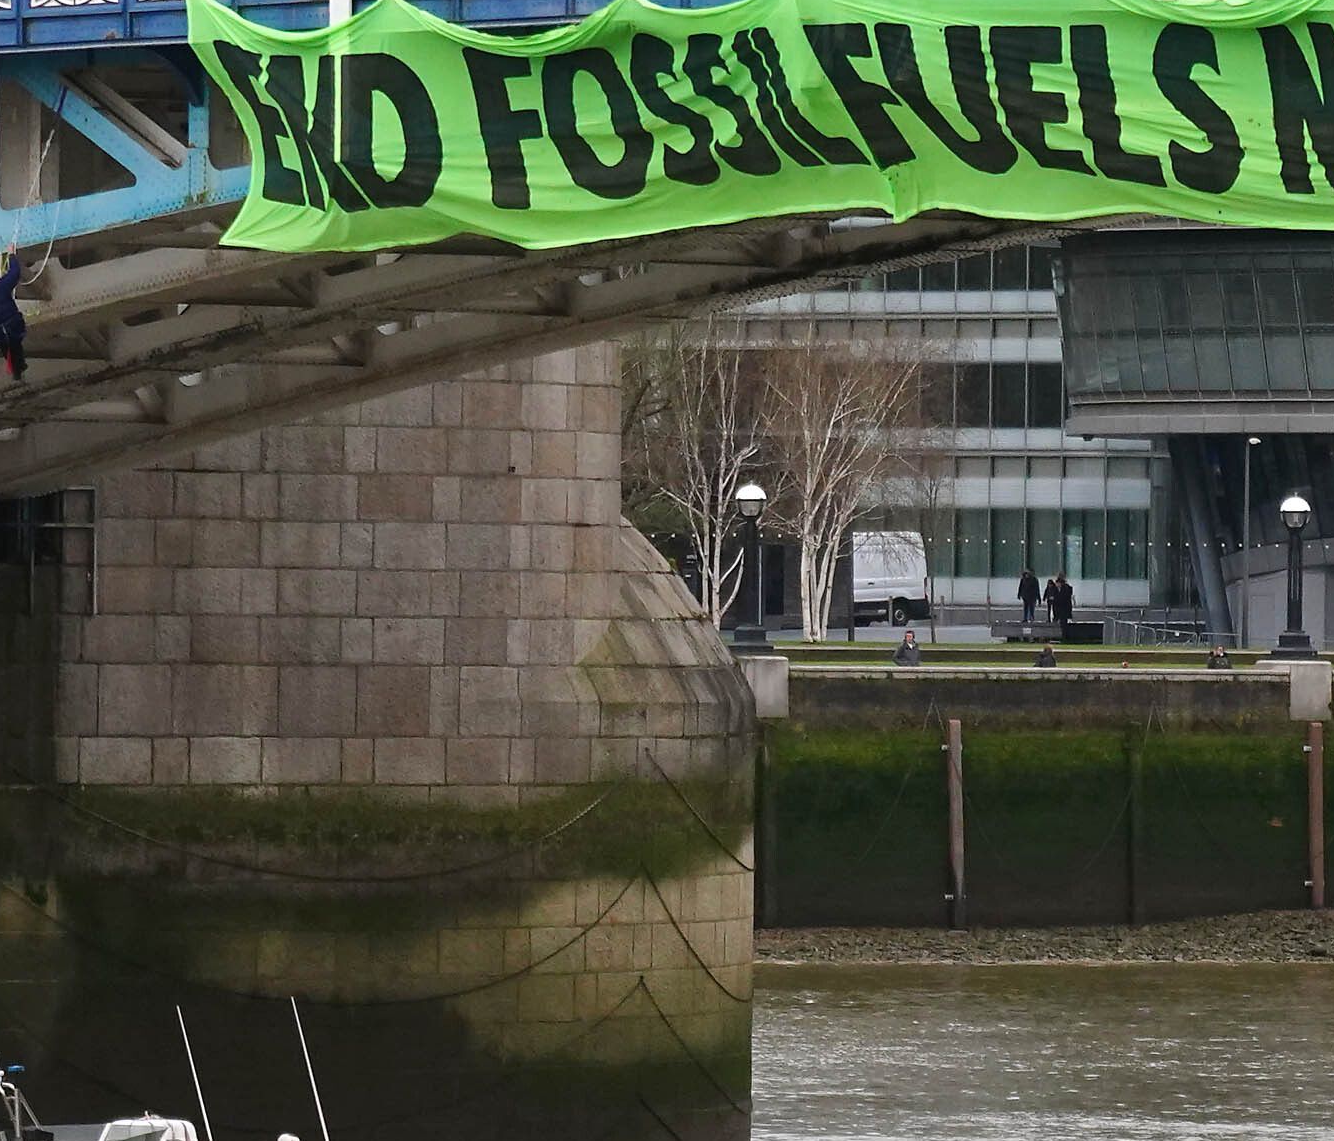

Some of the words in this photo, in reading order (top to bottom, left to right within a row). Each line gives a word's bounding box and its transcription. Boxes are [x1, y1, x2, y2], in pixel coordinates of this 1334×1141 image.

[213, 40, 442, 213] END
[463, 26, 871, 209] FOSSIL
[803, 22, 1244, 194] FUELS
